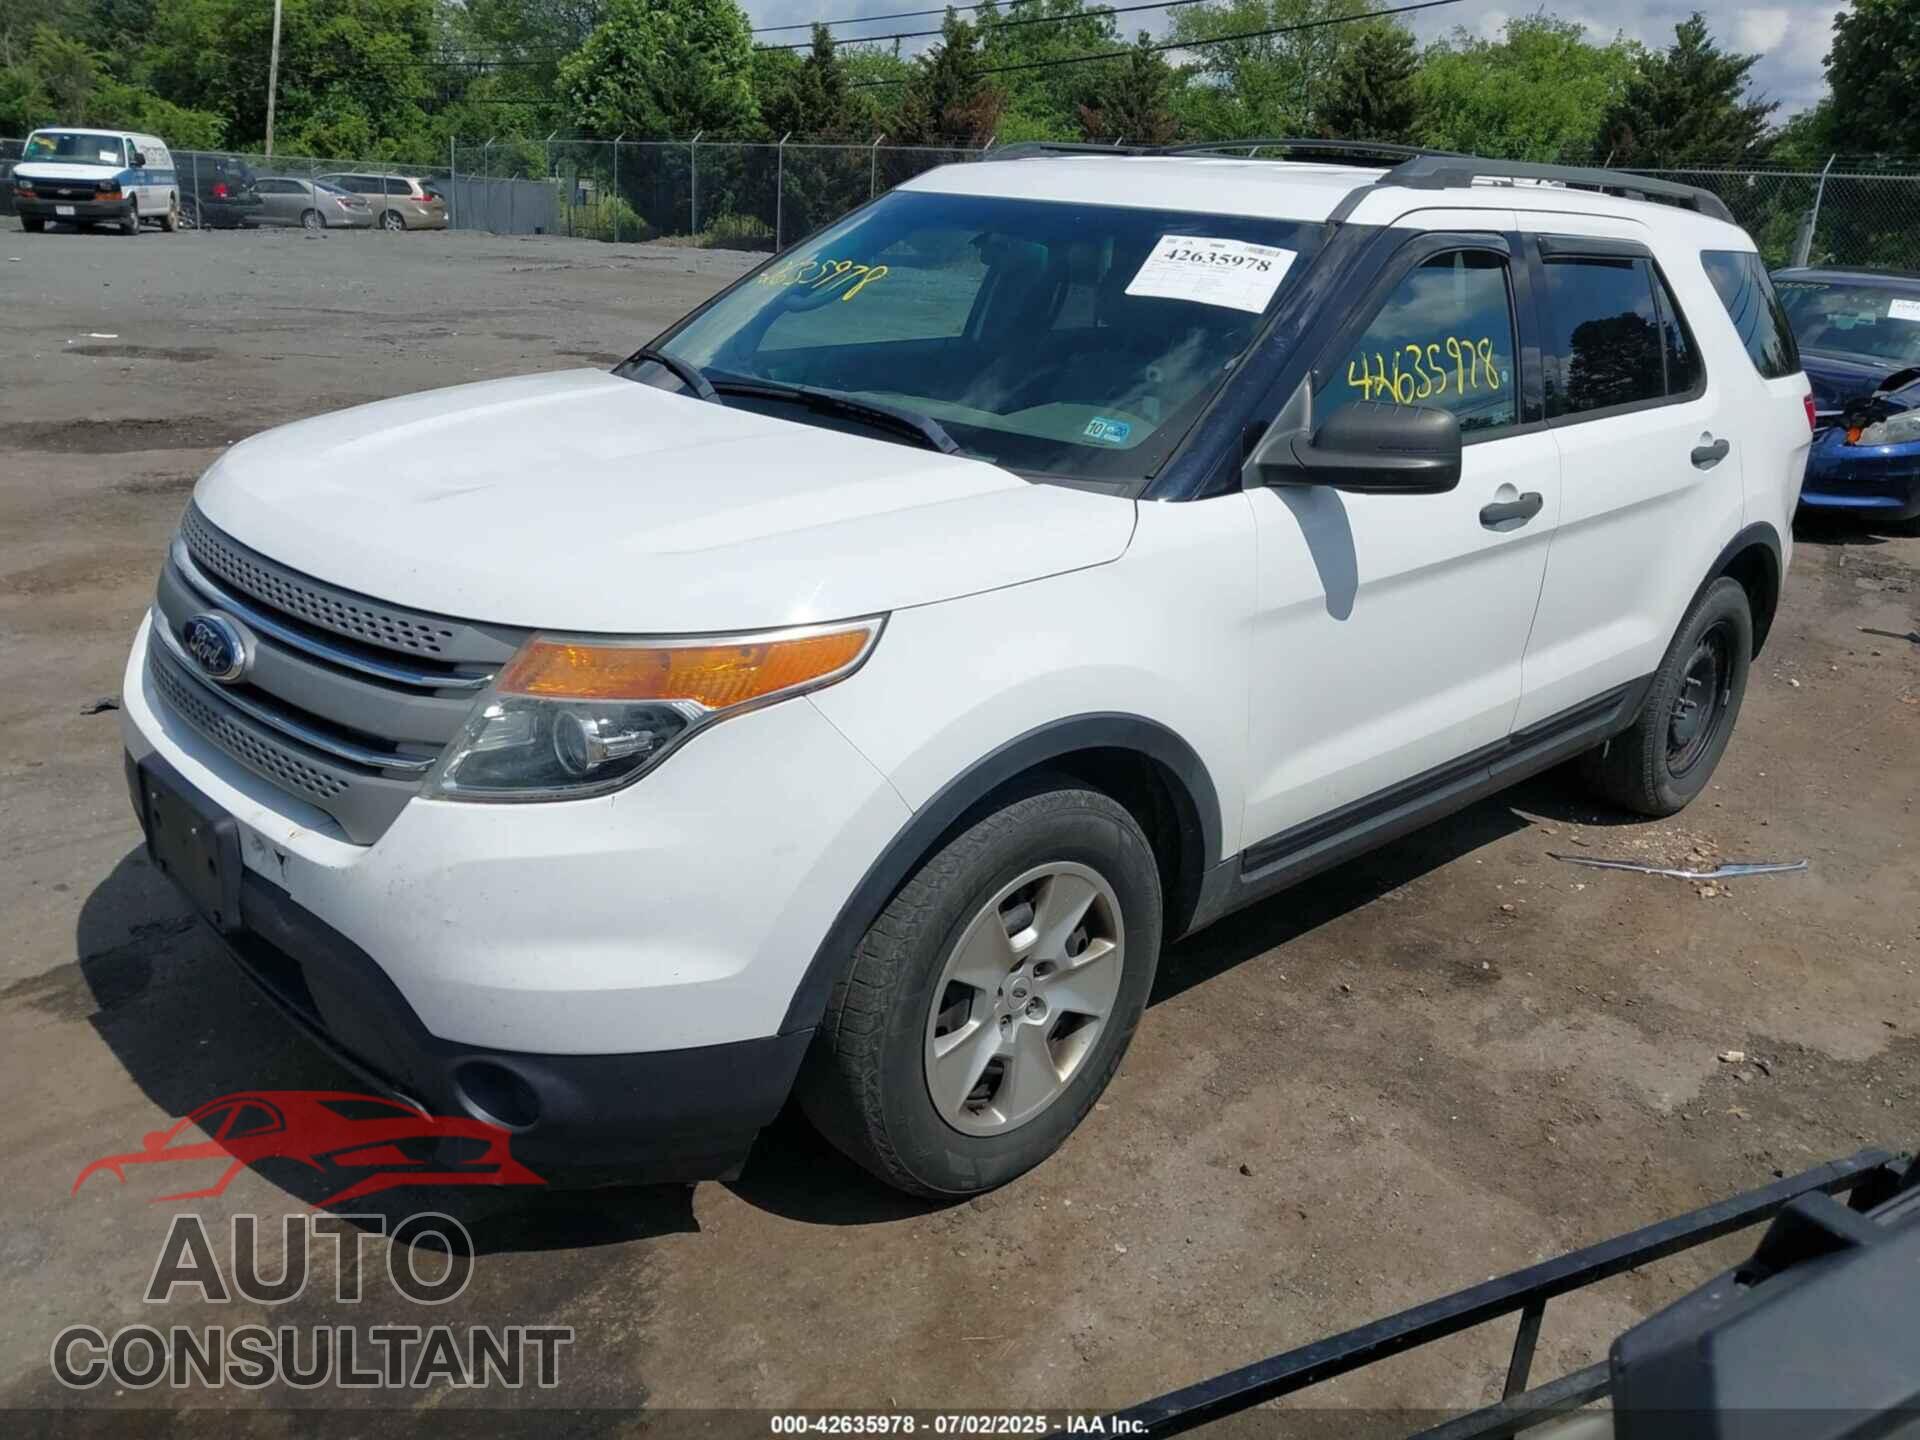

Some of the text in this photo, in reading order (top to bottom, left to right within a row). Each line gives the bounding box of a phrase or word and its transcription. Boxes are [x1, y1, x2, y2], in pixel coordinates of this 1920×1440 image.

[1165, 248, 1272, 272] 42635978
[1348, 336, 1500, 404] 42635978
[1089, 422, 1104, 435] 10
